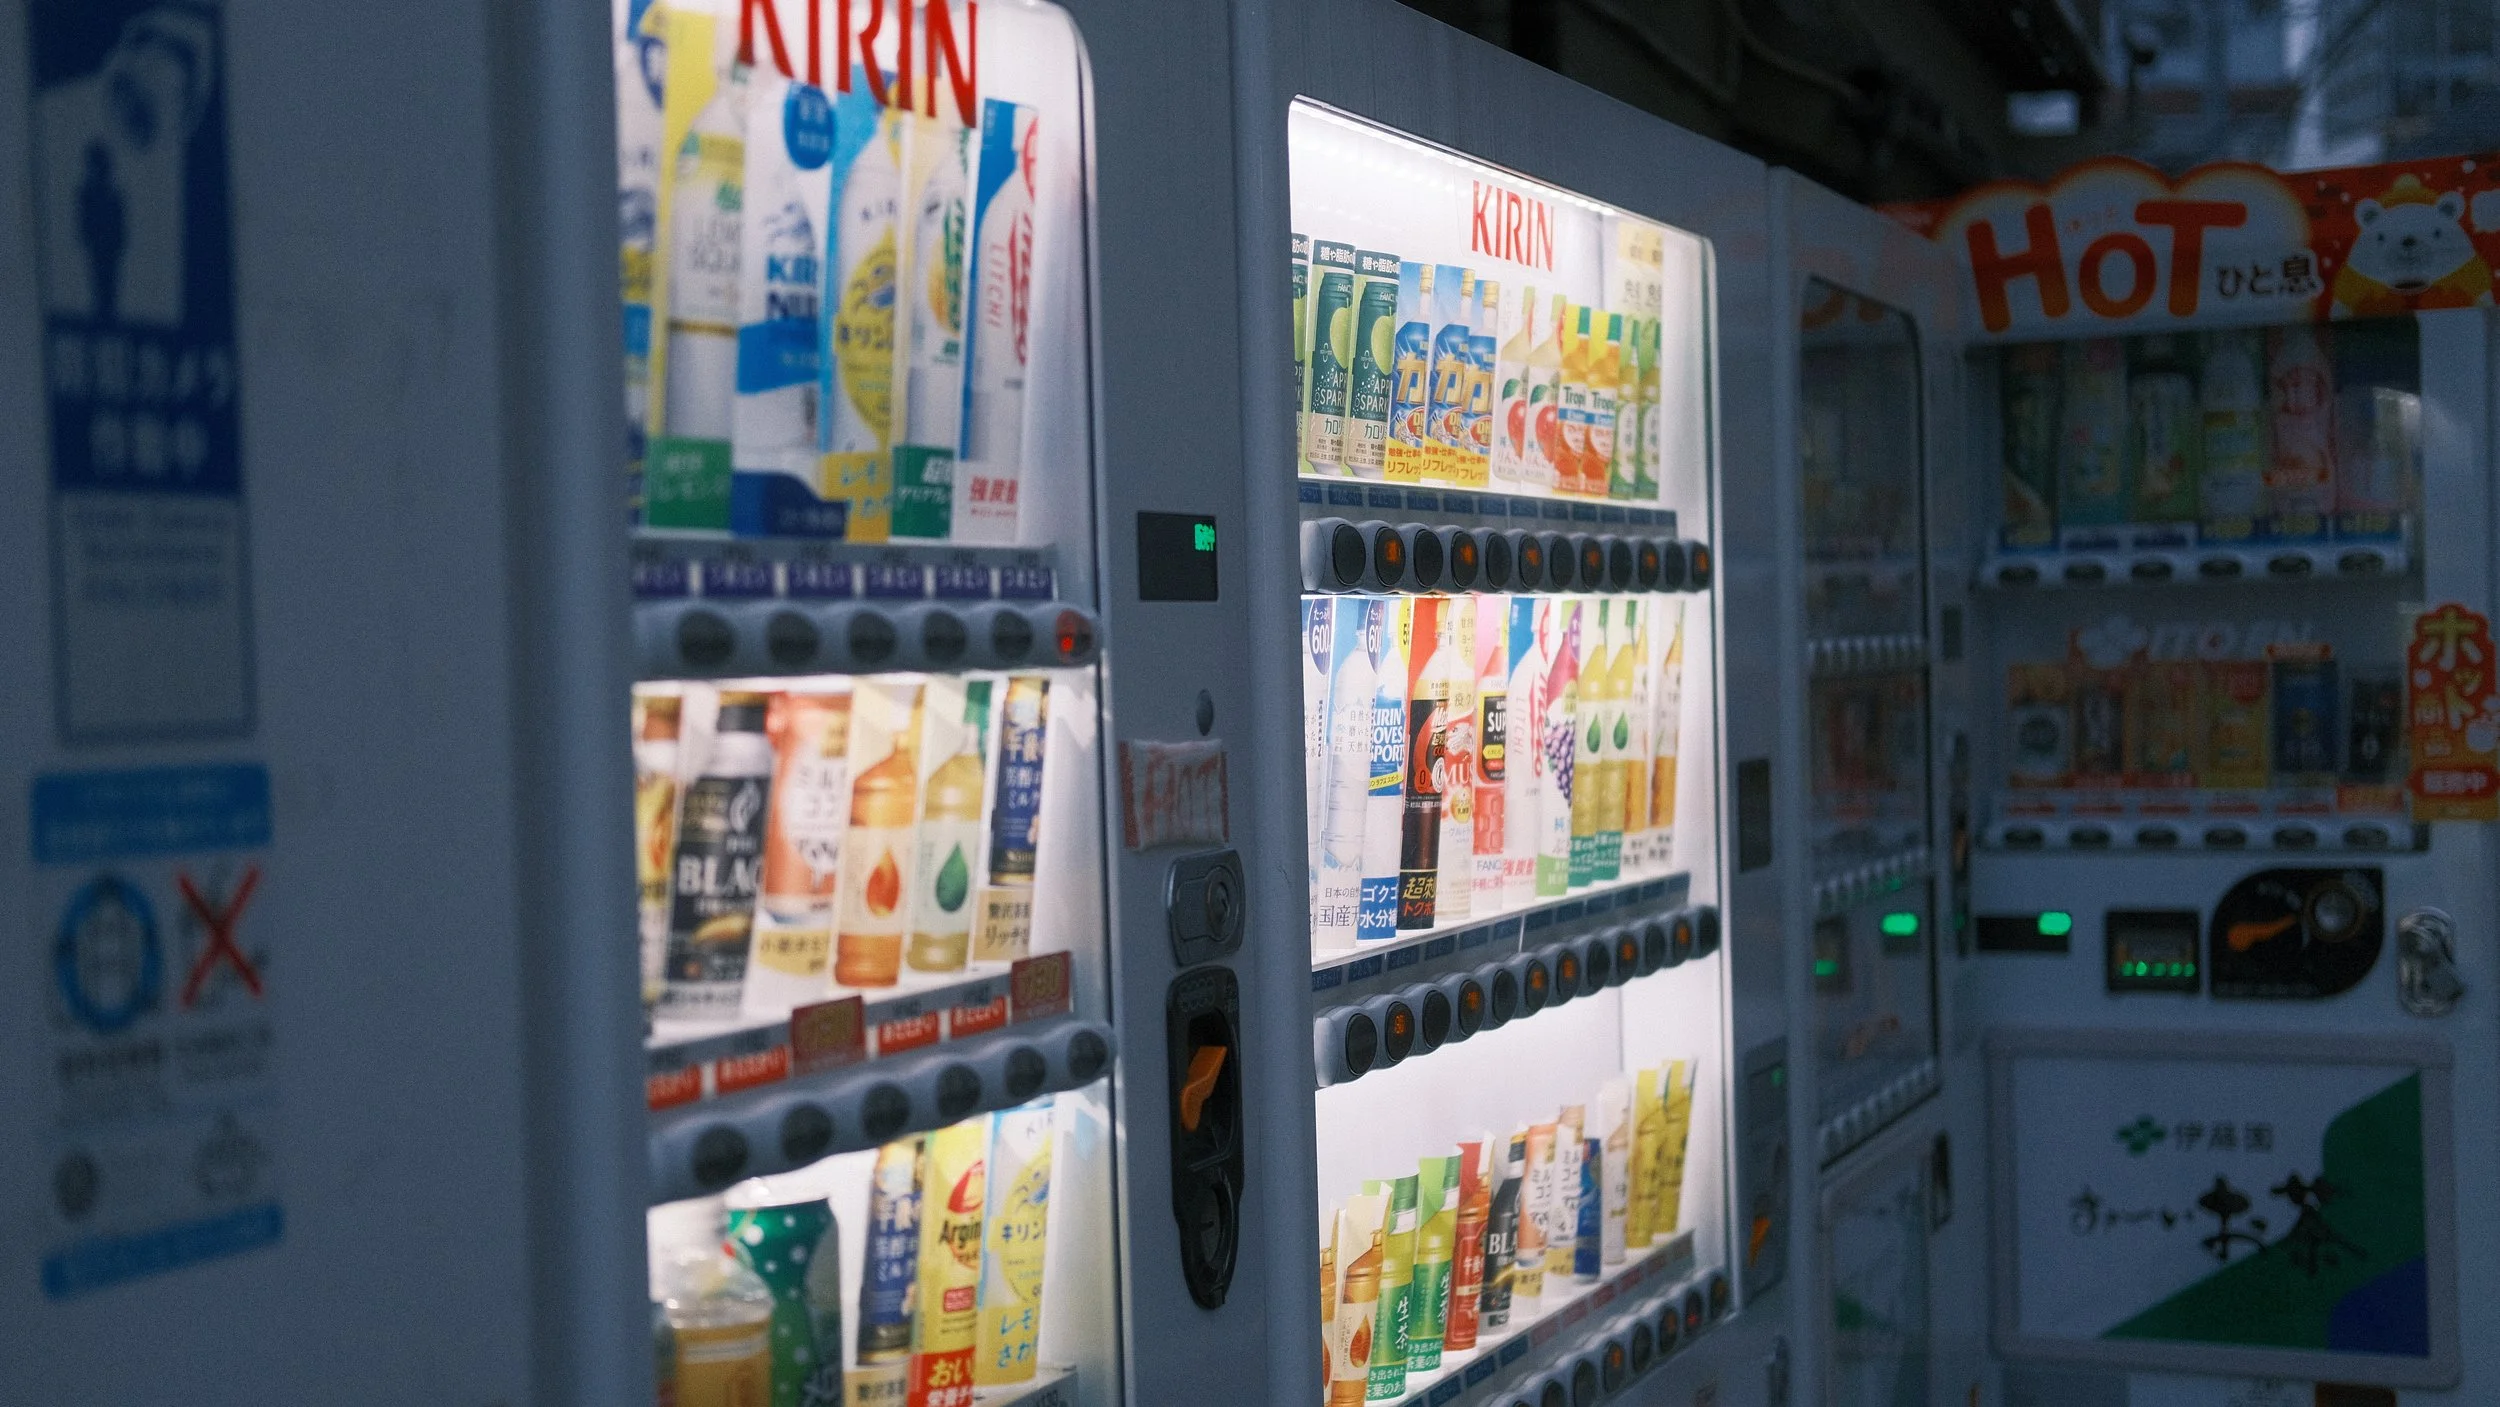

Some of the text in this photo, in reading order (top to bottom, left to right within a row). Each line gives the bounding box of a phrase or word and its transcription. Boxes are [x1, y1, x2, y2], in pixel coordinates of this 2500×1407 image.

[1471, 180, 1555, 273] KIRIN
[2215, 254, 2318, 298] ひと息
[1312, 624, 1331, 654] 600
[2174, 1121, 2274, 1151] 伊藤園
[1395, 1296, 1409, 1350] 生茶
